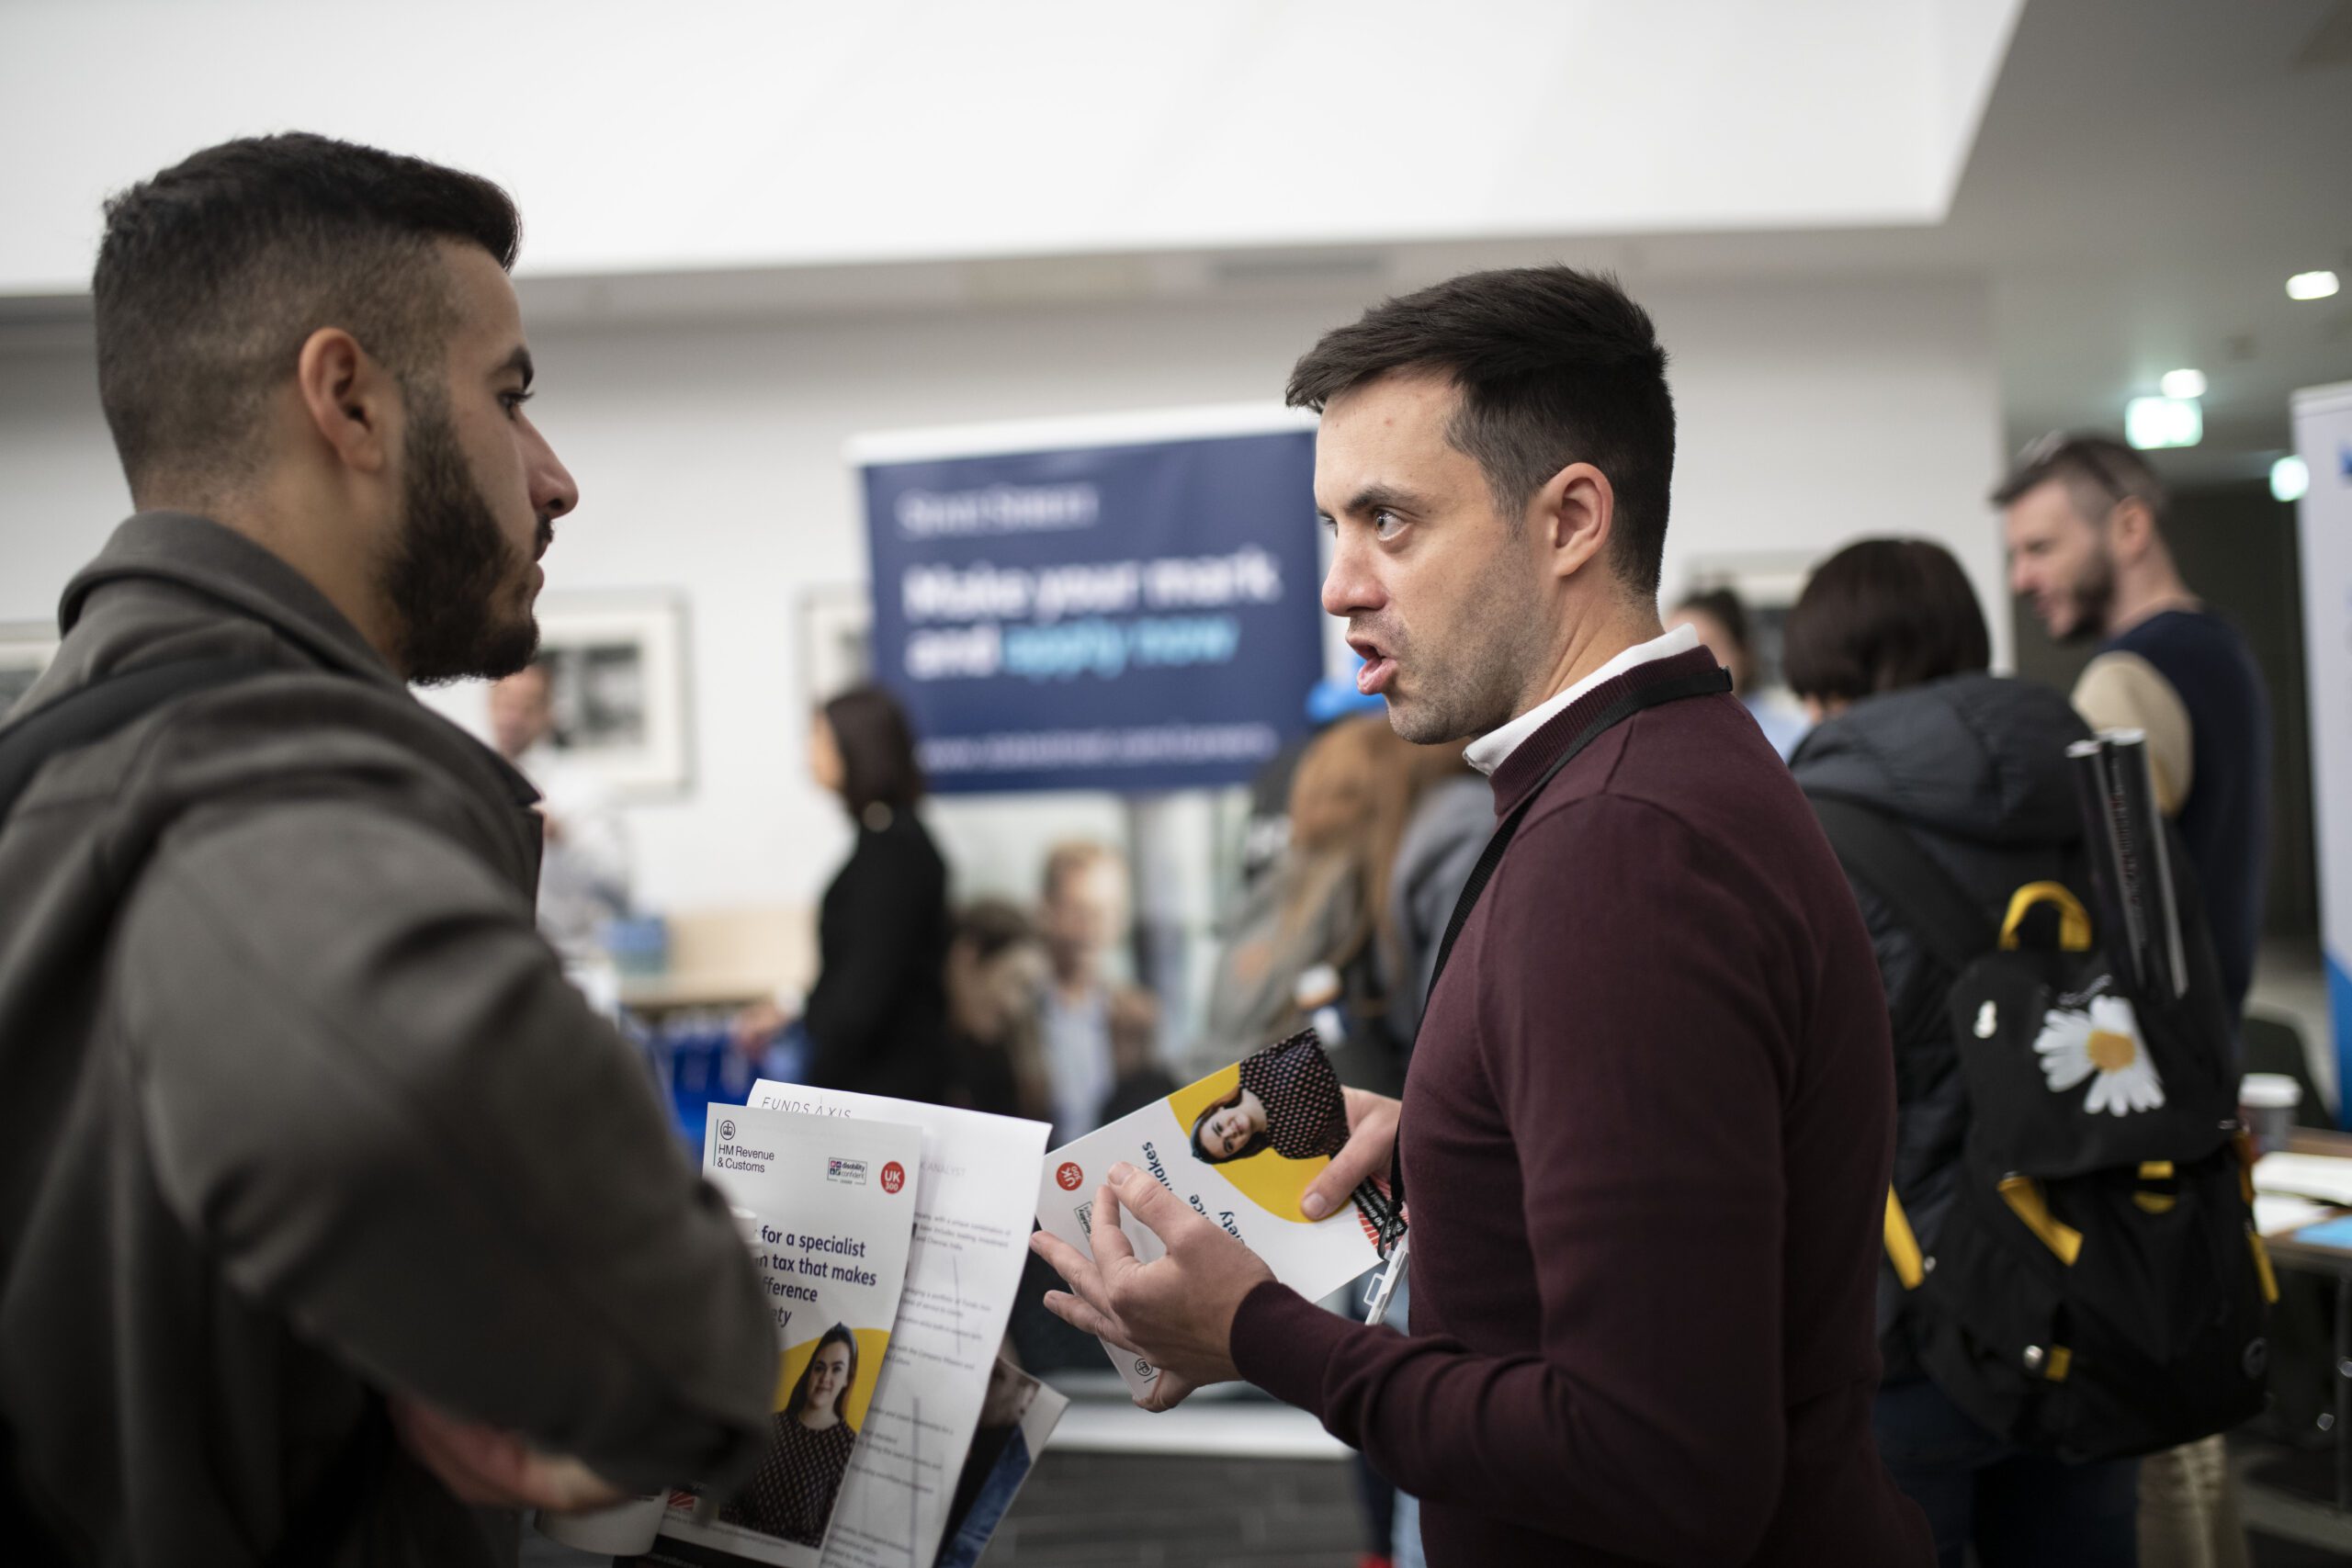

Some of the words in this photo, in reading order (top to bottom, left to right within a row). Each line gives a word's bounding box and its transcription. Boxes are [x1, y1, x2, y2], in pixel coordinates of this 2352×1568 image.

[906, 565, 1030, 618] Make
[1036, 562, 1138, 619] your
[1147, 549, 1280, 606] mark
[909, 625, 998, 675] and
[1004, 619, 1125, 676] apply
[1132, 618, 1237, 661] now
[761, 1096, 810, 1114] FUNDS
[718, 1144, 734, 1156] HM
[735, 1145, 775, 1161] Revenue
[717, 1157, 725, 1168] &
[725, 1158, 766, 1173] Customs
[842, 1161, 865, 1173] disability
[884, 1169, 901, 1183] UK
[1060, 1167, 1078, 1188] UK
[761, 1224, 783, 1245] for
[786, 1233, 796, 1247] a
[798, 1235, 867, 1258] specialist
[772, 1253, 797, 1272] tax
[798, 1256, 830, 1279] that
[831, 1265, 878, 1287] makes
